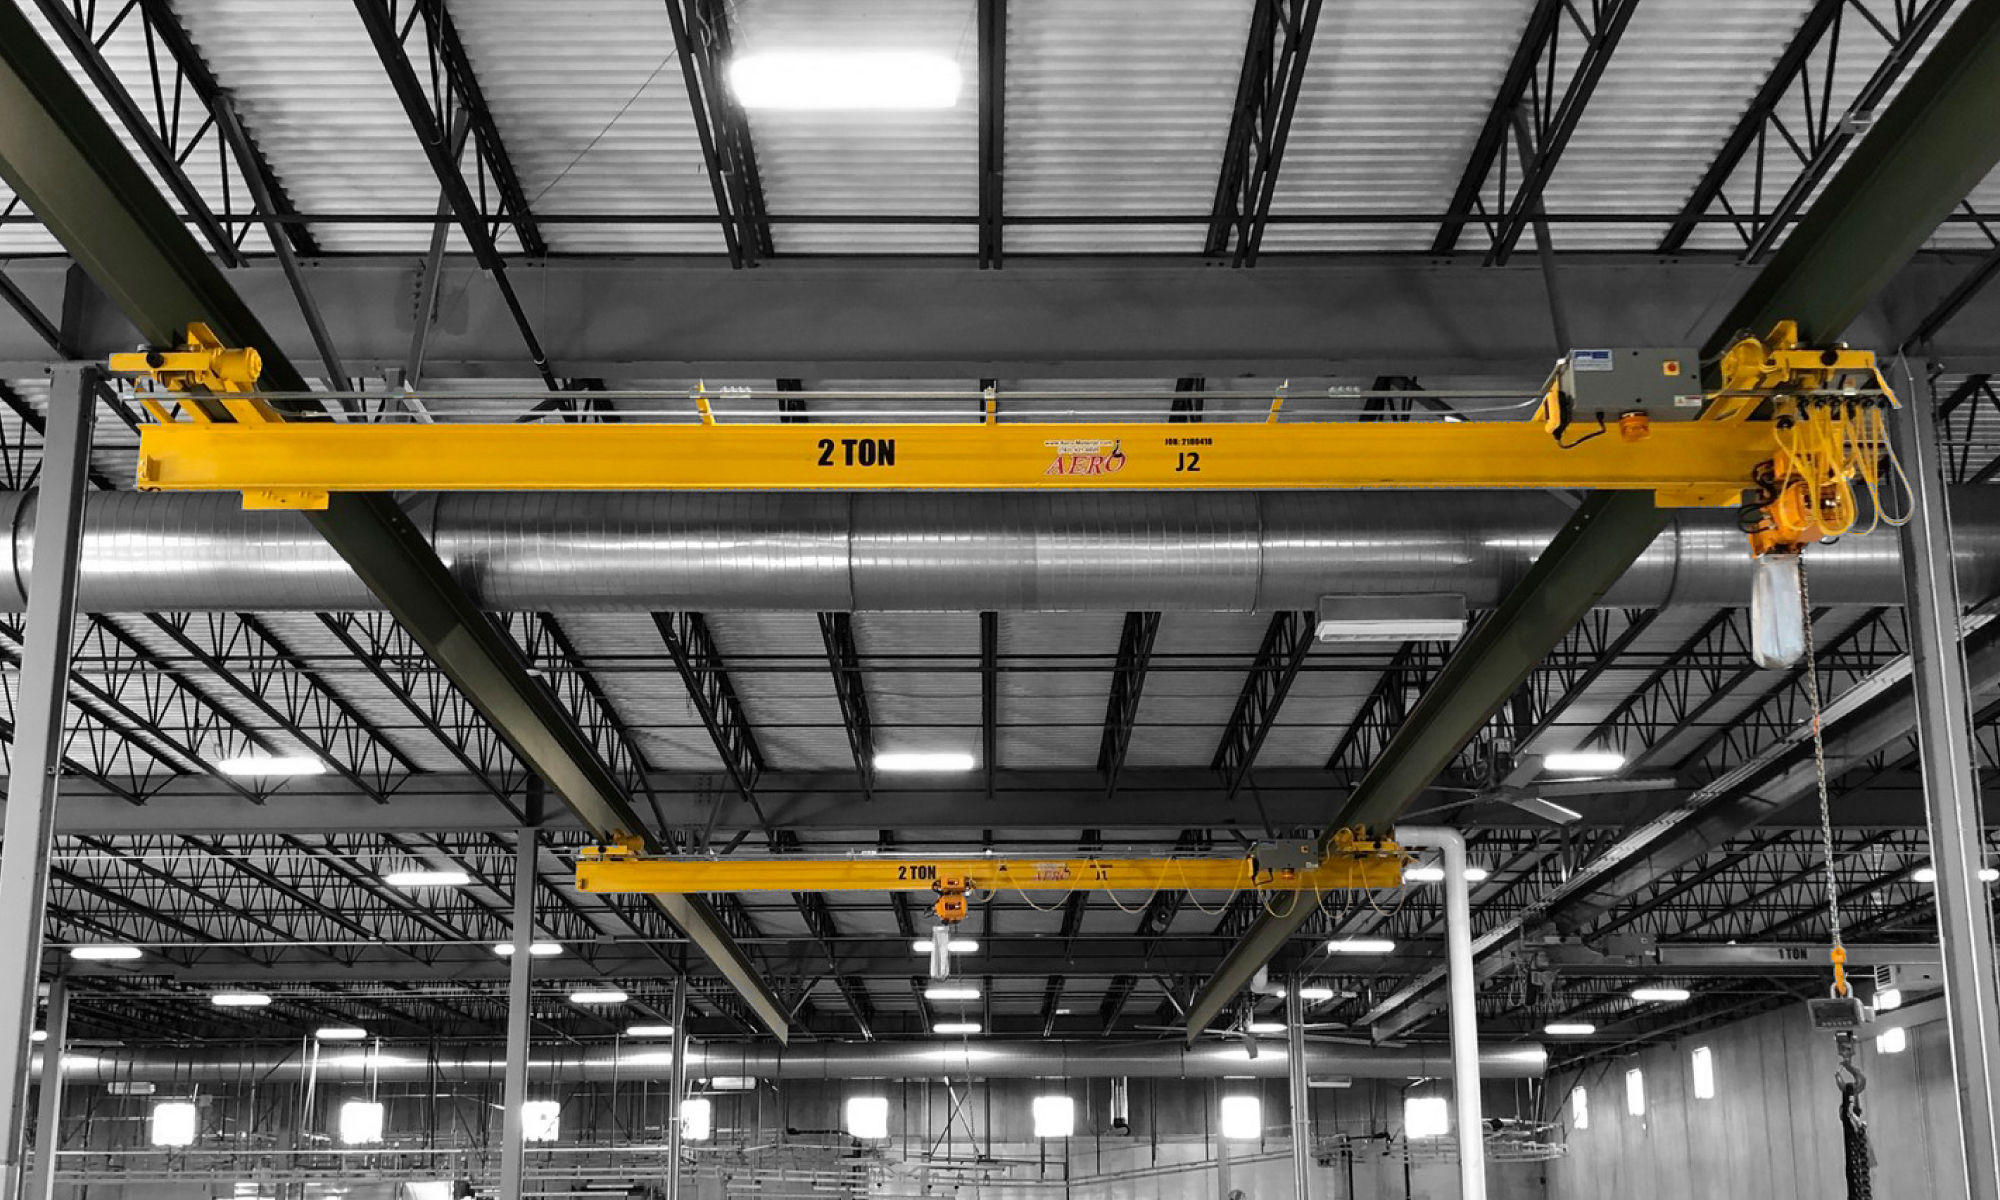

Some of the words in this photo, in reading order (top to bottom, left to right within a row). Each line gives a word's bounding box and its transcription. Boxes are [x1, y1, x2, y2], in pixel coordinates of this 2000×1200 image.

[817, 439, 835, 466] 2
[841, 438, 896, 467] TON
[1175, 452, 1200, 472] J2
[1045, 452, 1127, 476] AERO
[898, 865, 907, 880] 2
[910, 864, 936, 880] TON
[1785, 947, 1808, 960] TON
